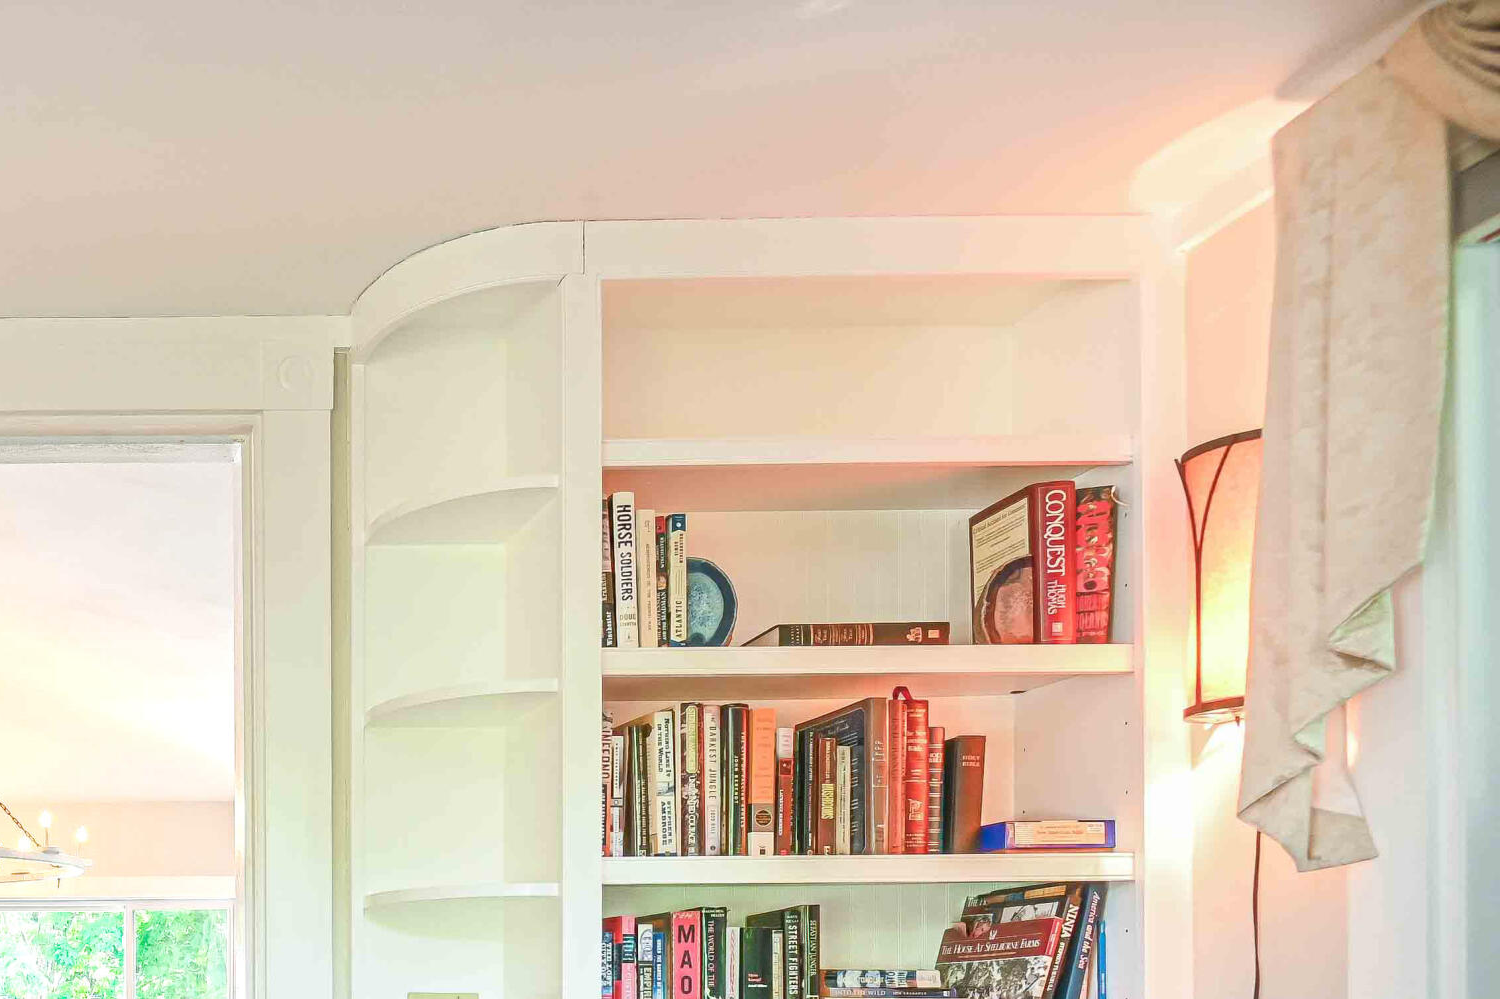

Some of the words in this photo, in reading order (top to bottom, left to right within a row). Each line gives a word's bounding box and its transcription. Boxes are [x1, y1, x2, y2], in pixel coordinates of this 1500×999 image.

[617, 505, 632, 548] HORSE
[1043, 489, 1066, 576] CONQUEST
[620, 552, 633, 601] SOLDIERS
[1047, 580, 1057, 615] THOMAS
[1057, 585, 1067, 608] HUGH
[709, 726, 717, 763] DARKEST
[709, 768, 717, 799] JUNGLE
[822, 784, 834, 819] MUSHROOMS
[1060, 904, 1079, 939] NINJA
[1088, 891, 1101, 924] America
[788, 925, 798, 954] STREET
[942, 946, 953, 955] THE
[954, 944, 974, 954] HOUSE
[985, 941, 1019, 952] SHELBURNE
[1020, 939, 1040, 948] FARMS
[1081, 941, 1092, 953] the
[1084, 925, 1093, 940] and
[678, 925, 695, 995] MAO
[708, 963, 714, 973] OF
[789, 958, 798, 995] FIGHTERS
[1078, 955, 1088, 970] Sea
